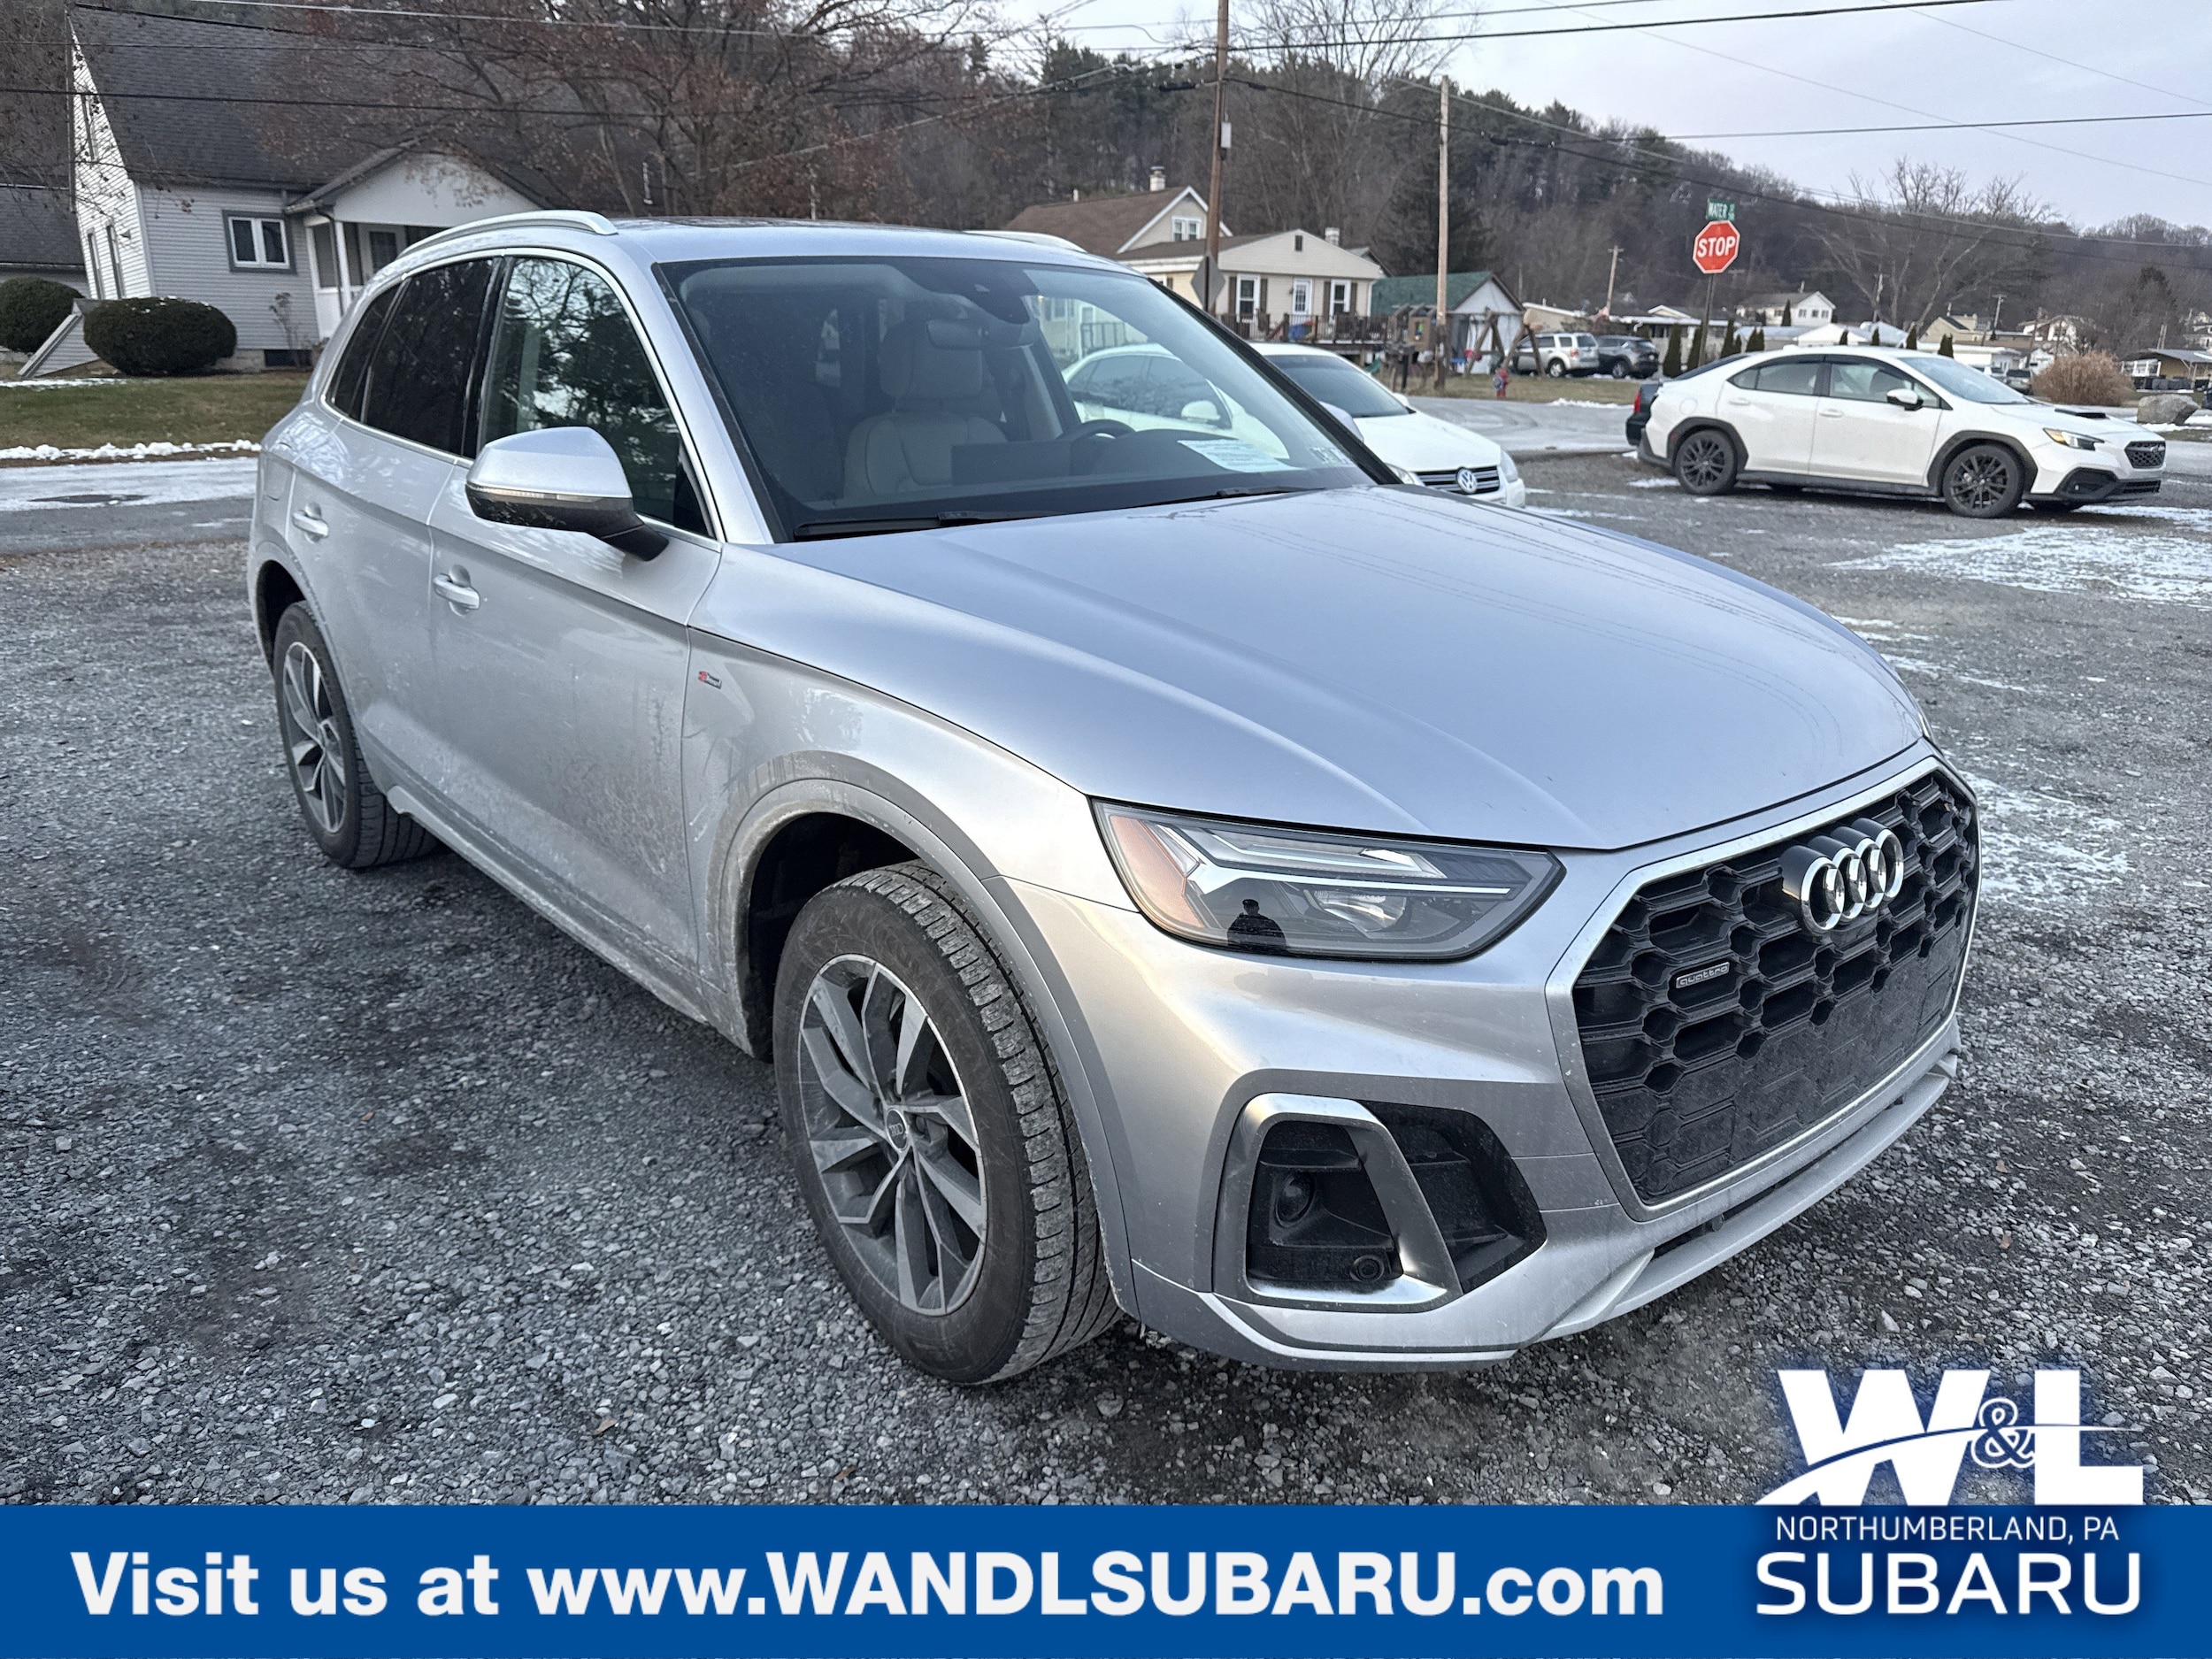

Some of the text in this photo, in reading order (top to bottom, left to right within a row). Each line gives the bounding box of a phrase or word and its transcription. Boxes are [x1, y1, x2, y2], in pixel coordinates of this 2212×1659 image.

[1708, 202, 1728, 219] WATER
[1697, 236, 1736, 257] STOP
[1679, 965, 1728, 986] quattro
